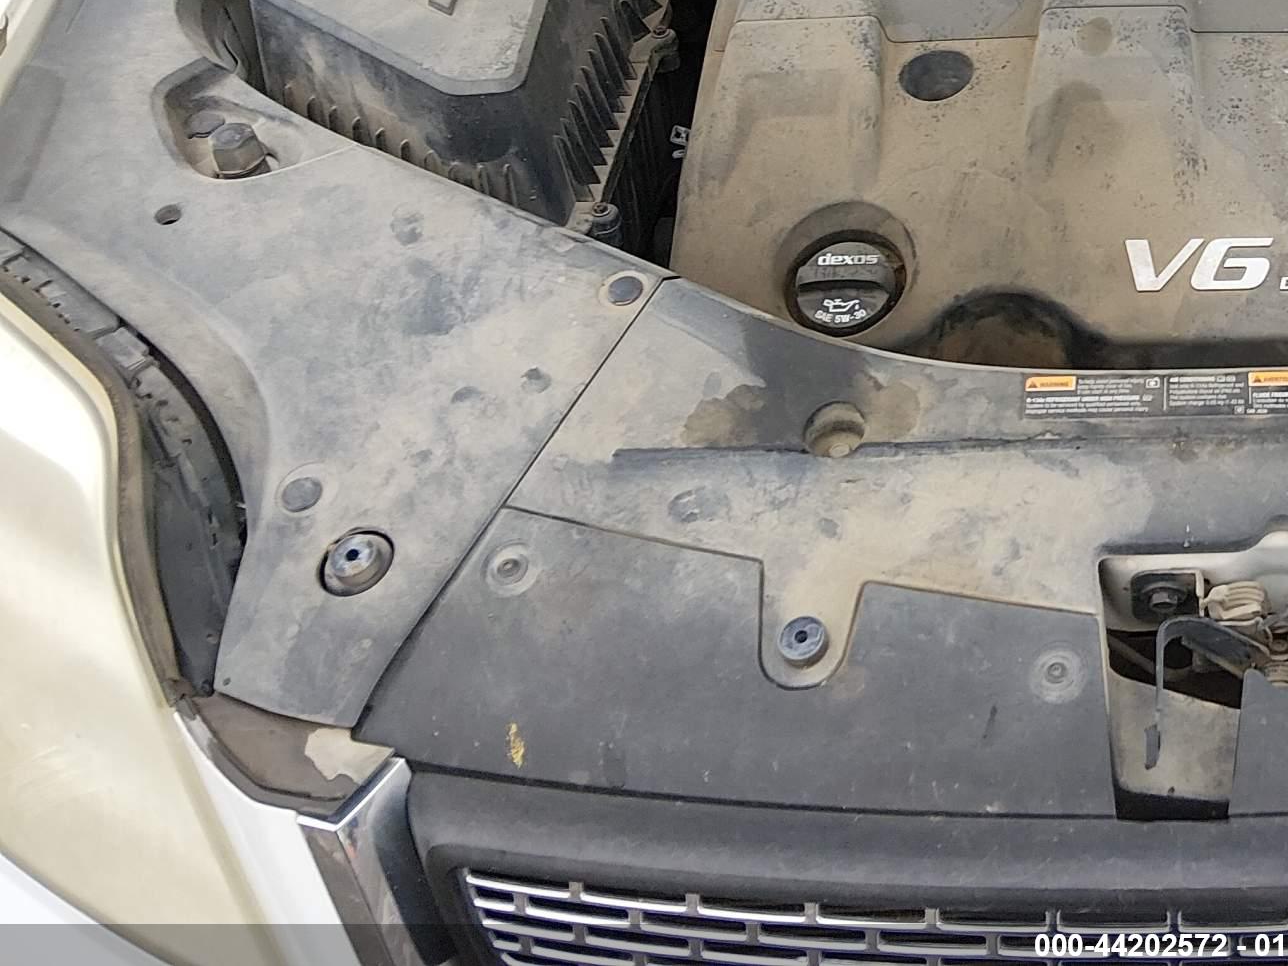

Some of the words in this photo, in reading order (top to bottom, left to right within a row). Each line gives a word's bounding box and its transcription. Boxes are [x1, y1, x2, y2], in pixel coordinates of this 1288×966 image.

[817, 253, 880, 266] dexos
[1125, 237, 1274, 292] V6
[814, 309, 834, 324] SAE
[833, 309, 867, 324] 5W-30
